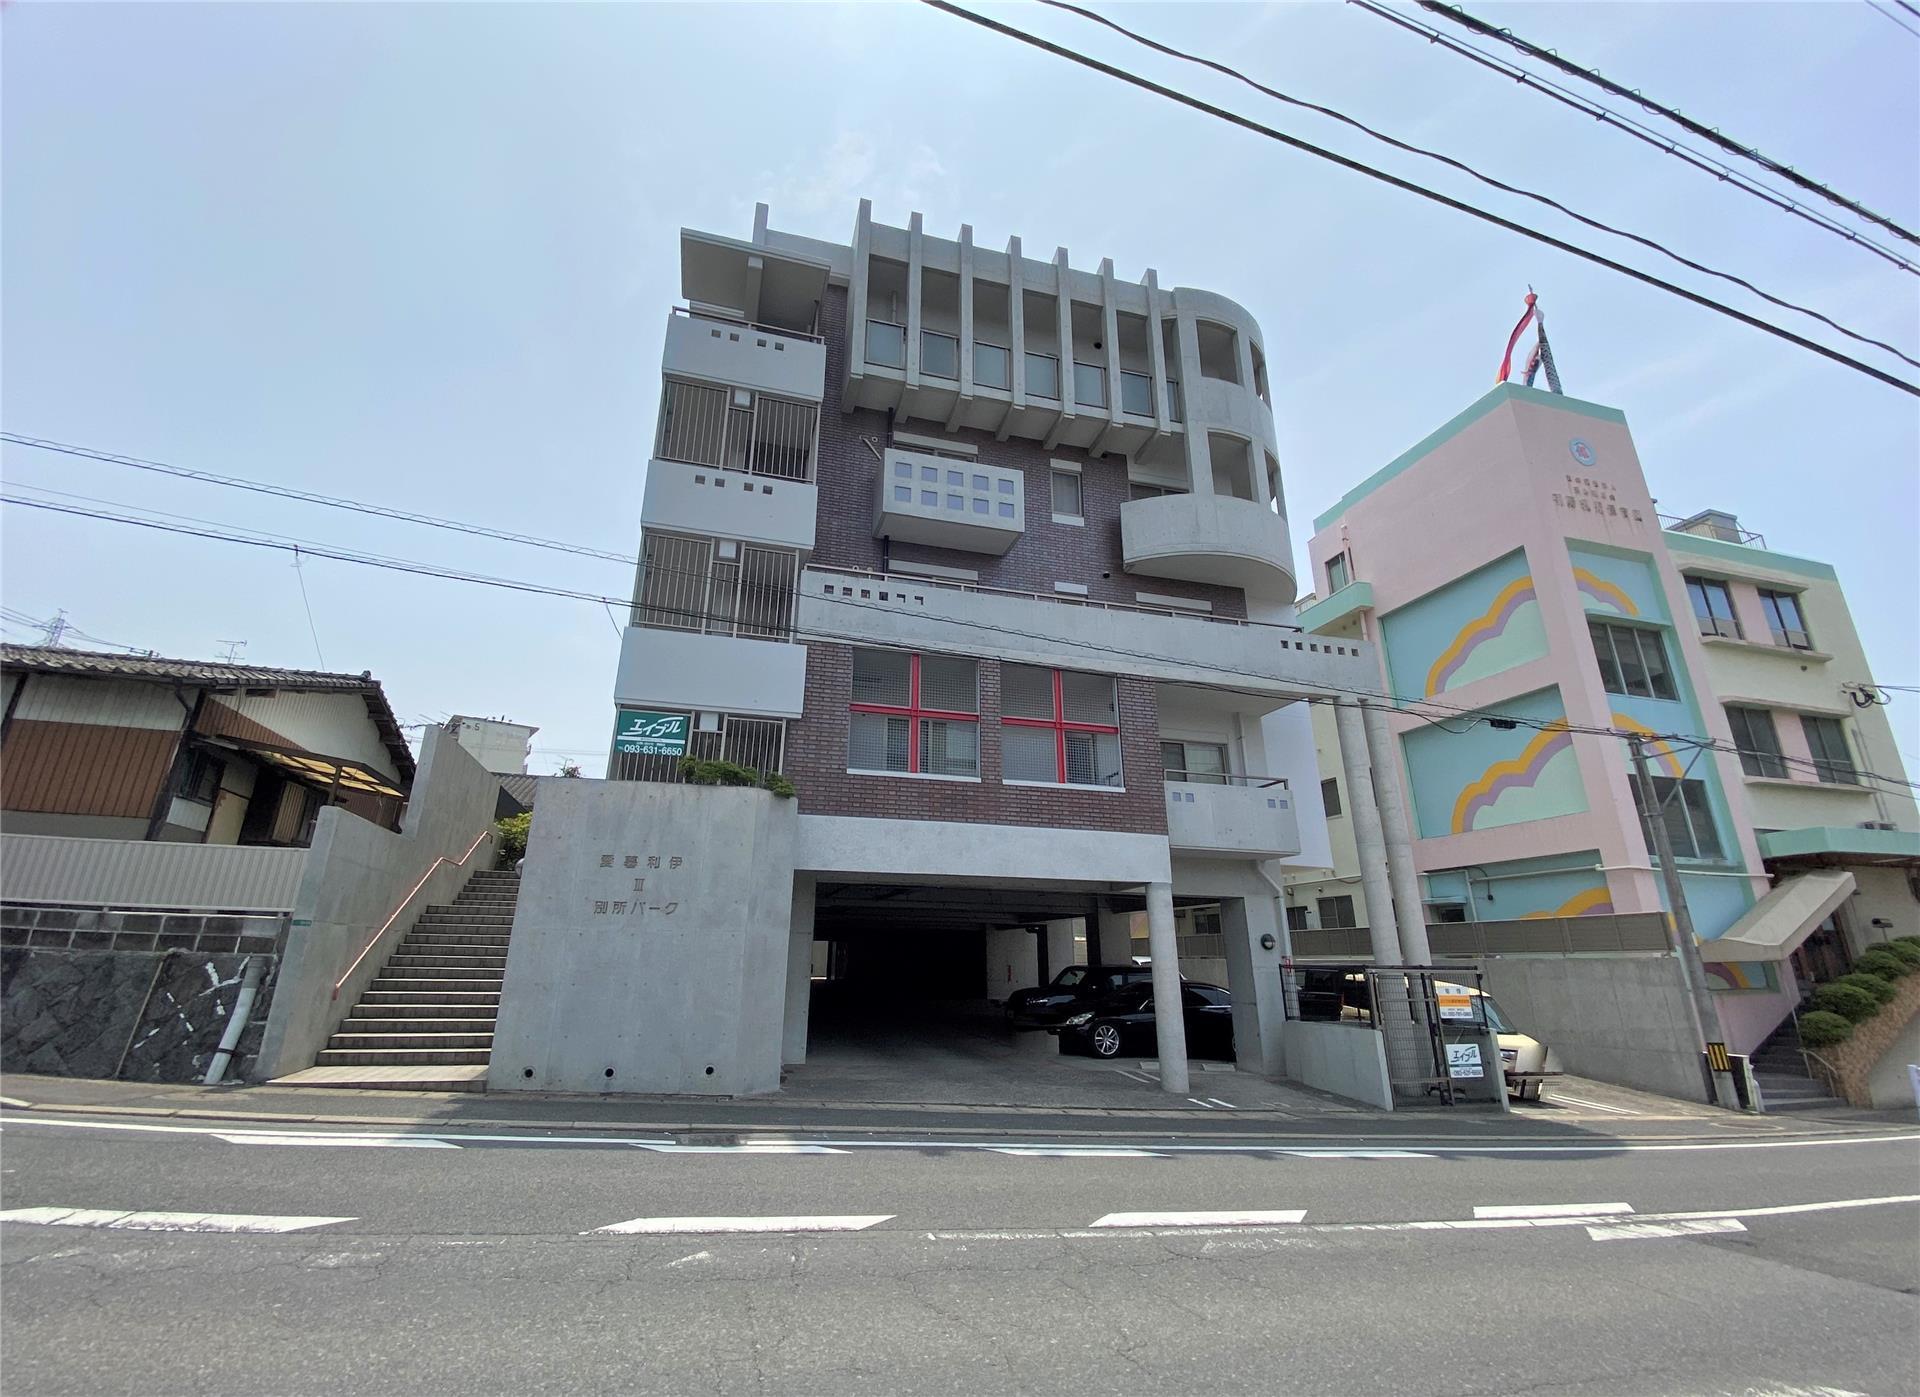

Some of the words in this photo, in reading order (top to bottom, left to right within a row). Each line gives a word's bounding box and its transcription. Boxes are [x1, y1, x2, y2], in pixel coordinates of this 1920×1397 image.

[622, 716, 684, 737] エイブル
[624, 744, 682, 756] 093-631-6650
[593, 900, 679, 916] 別所パーク
